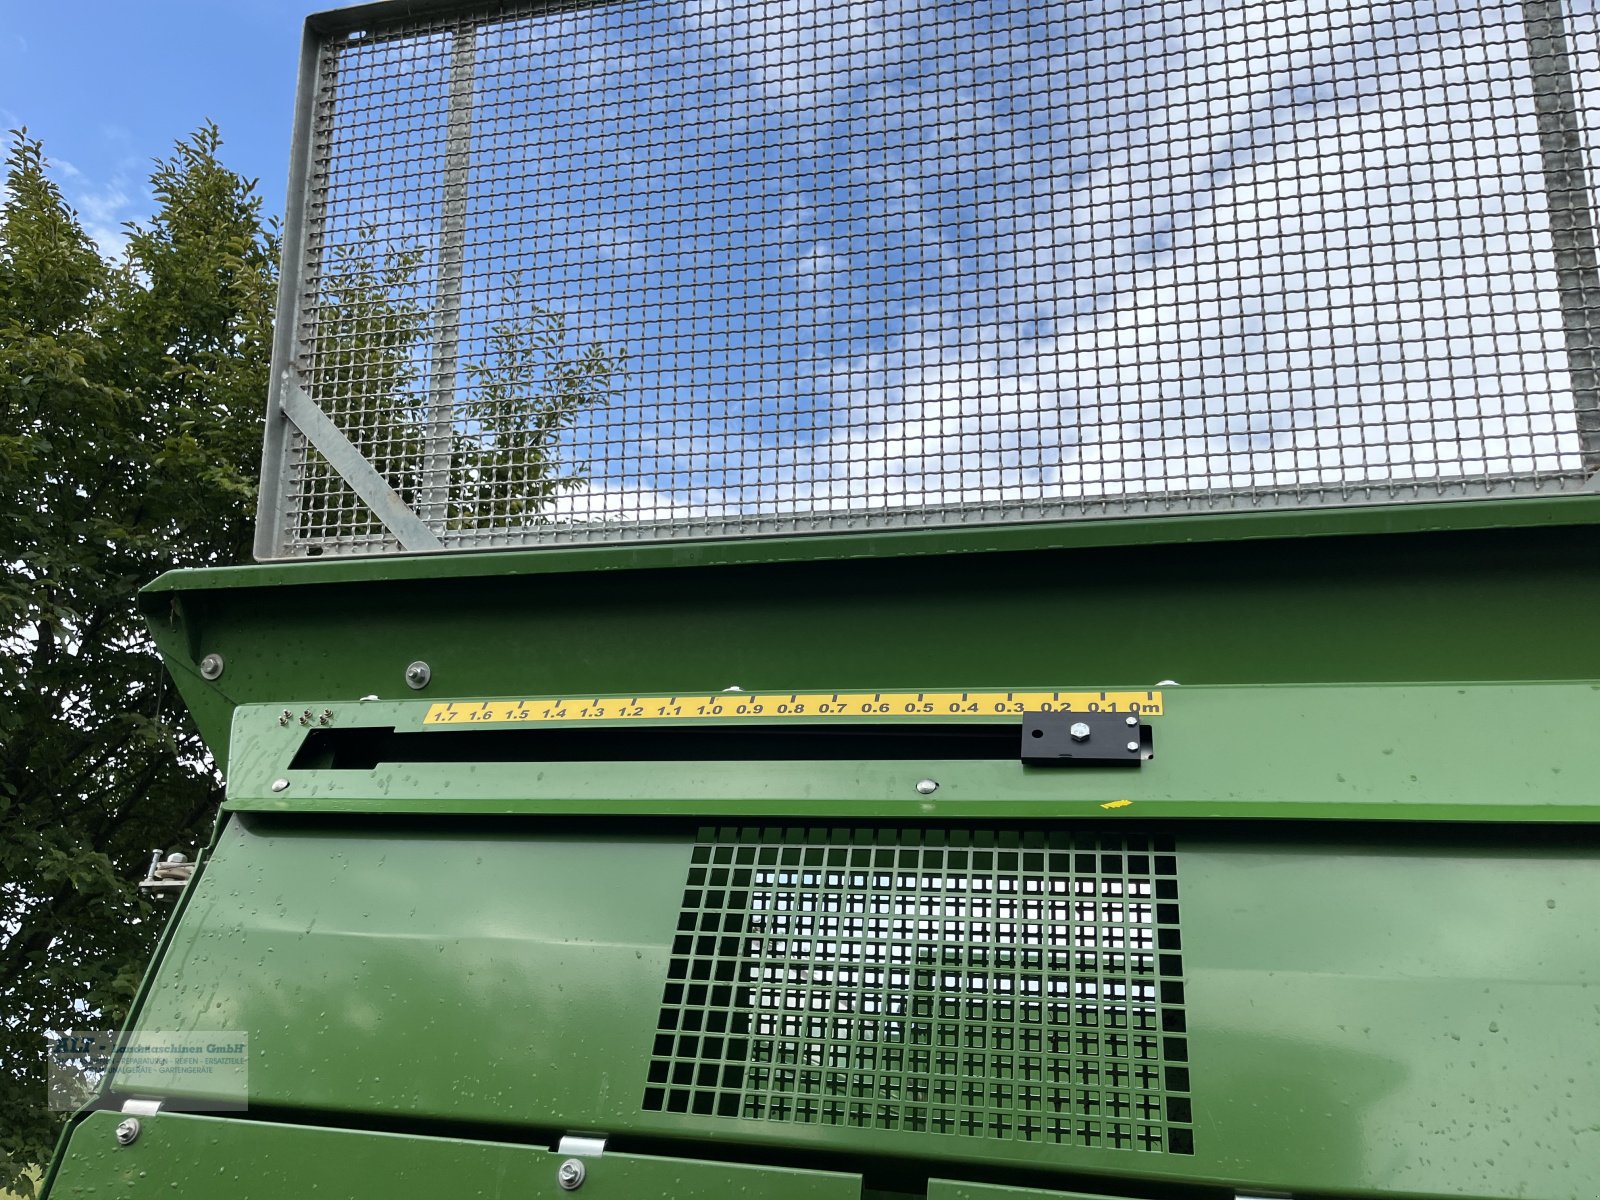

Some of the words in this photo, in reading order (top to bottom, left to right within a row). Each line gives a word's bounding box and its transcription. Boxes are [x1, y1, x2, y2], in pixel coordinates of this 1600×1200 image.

[434, 710, 458, 722] 1.7
[469, 710, 493, 720] 1.6
[505, 710, 529, 720] 1.5
[542, 708, 567, 718] 1.4
[580, 708, 605, 718] 1.3
[618, 706, 644, 717] 1.2
[657, 706, 682, 716] 1.1
[696, 705, 724, 715] 1.0
[736, 704, 764, 714] 0.9
[777, 704, 805, 714] 0.8
[818, 704, 847, 714] 0.7
[861, 703, 890, 713] 0.6
[904, 702, 934, 712] 0.5
[948, 702, 979, 712] 0.4
[994, 702, 1024, 712] 0.3
[1041, 702, 1071, 712] 0.2
[1088, 702, 1117, 712] 0.1
